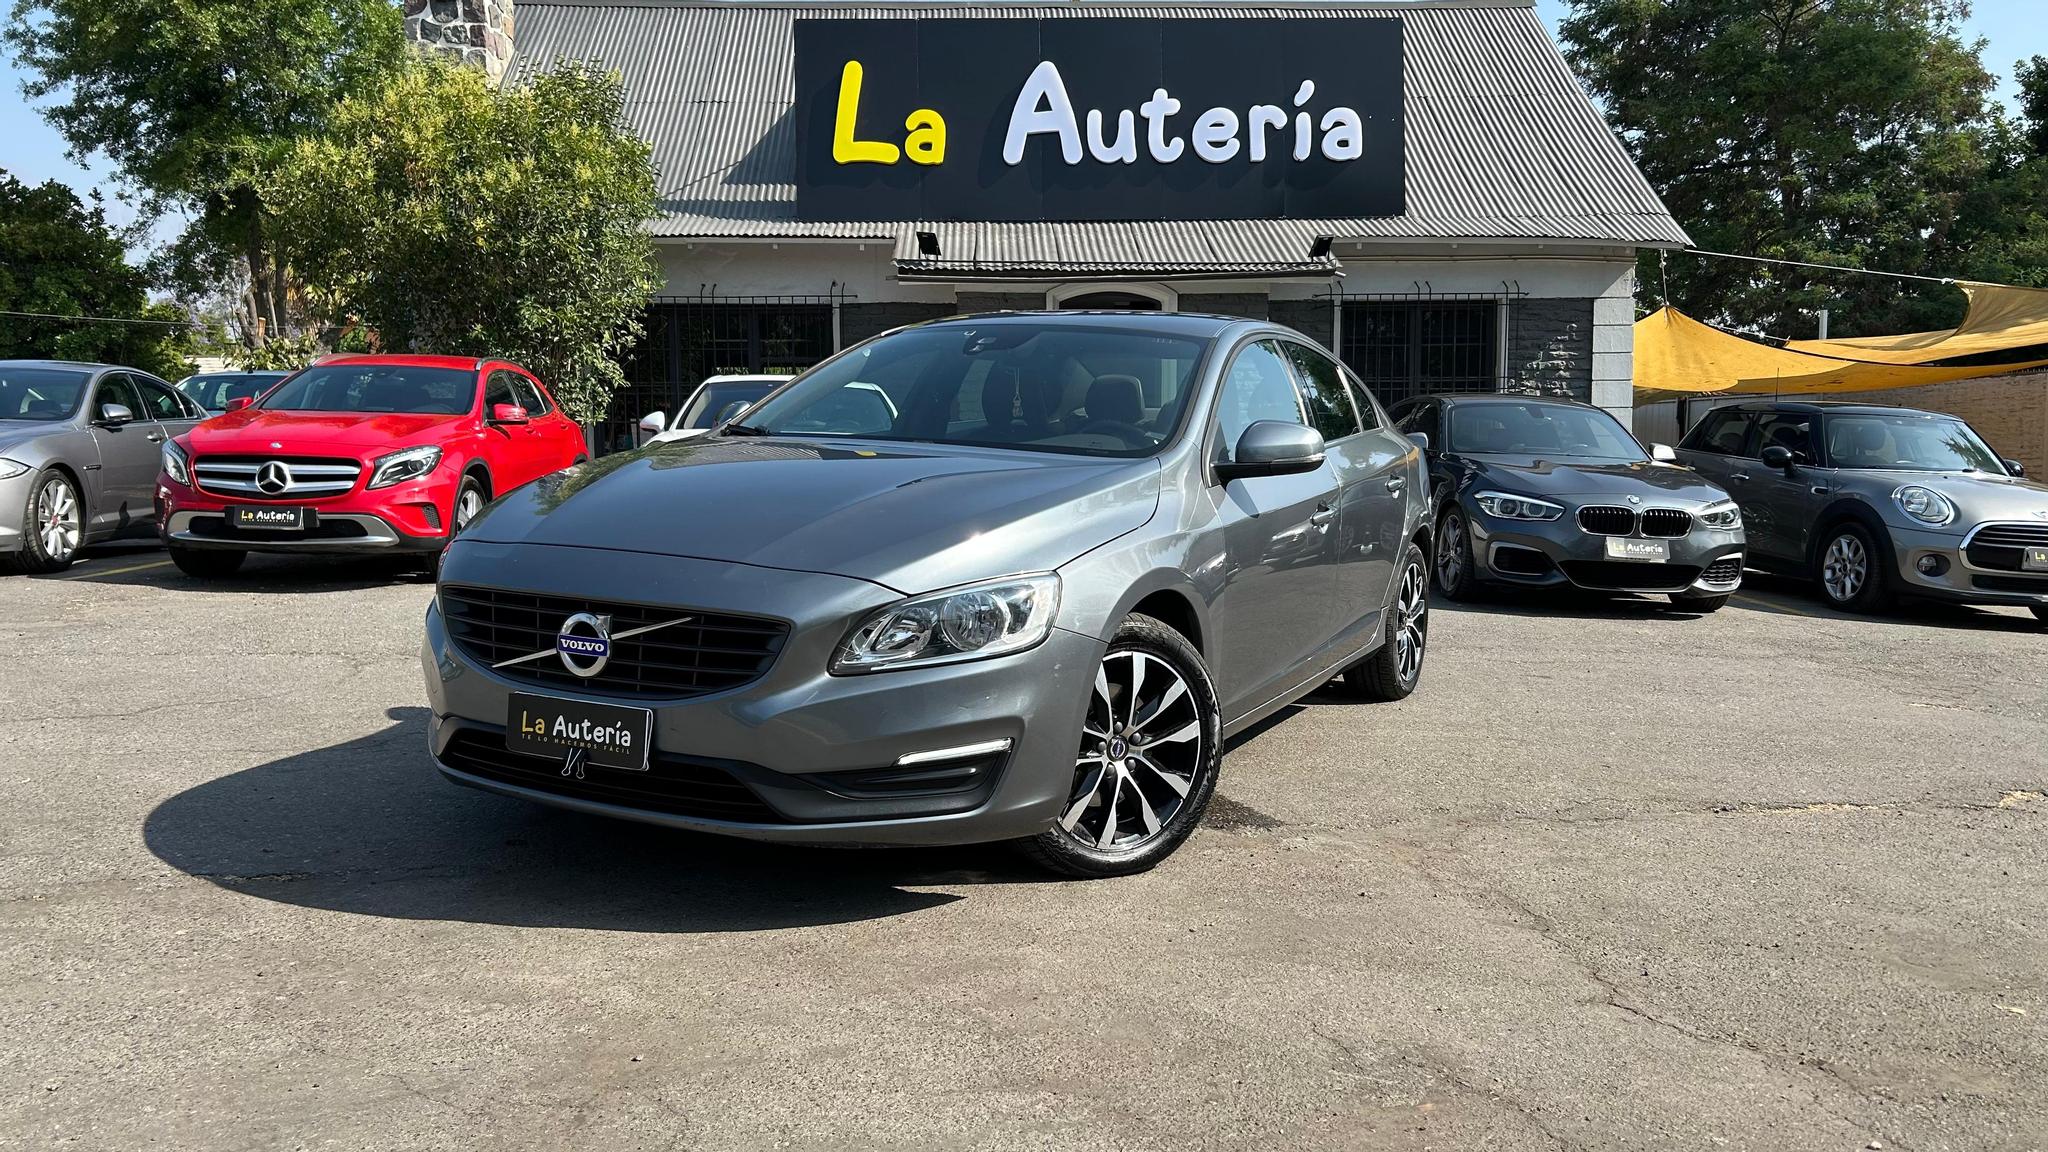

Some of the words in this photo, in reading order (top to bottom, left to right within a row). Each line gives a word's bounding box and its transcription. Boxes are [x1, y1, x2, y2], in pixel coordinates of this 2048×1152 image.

[832, 60, 947, 165] La
[1003, 60, 1364, 165] Autería
[241, 510, 254, 520] La
[2034, 551, 2046, 561] La
[560, 638, 605, 652] VOLVO
[522, 710, 545, 735] La
[552, 714, 632, 748] Autería
[554, 738, 598, 750] HACEMOS
